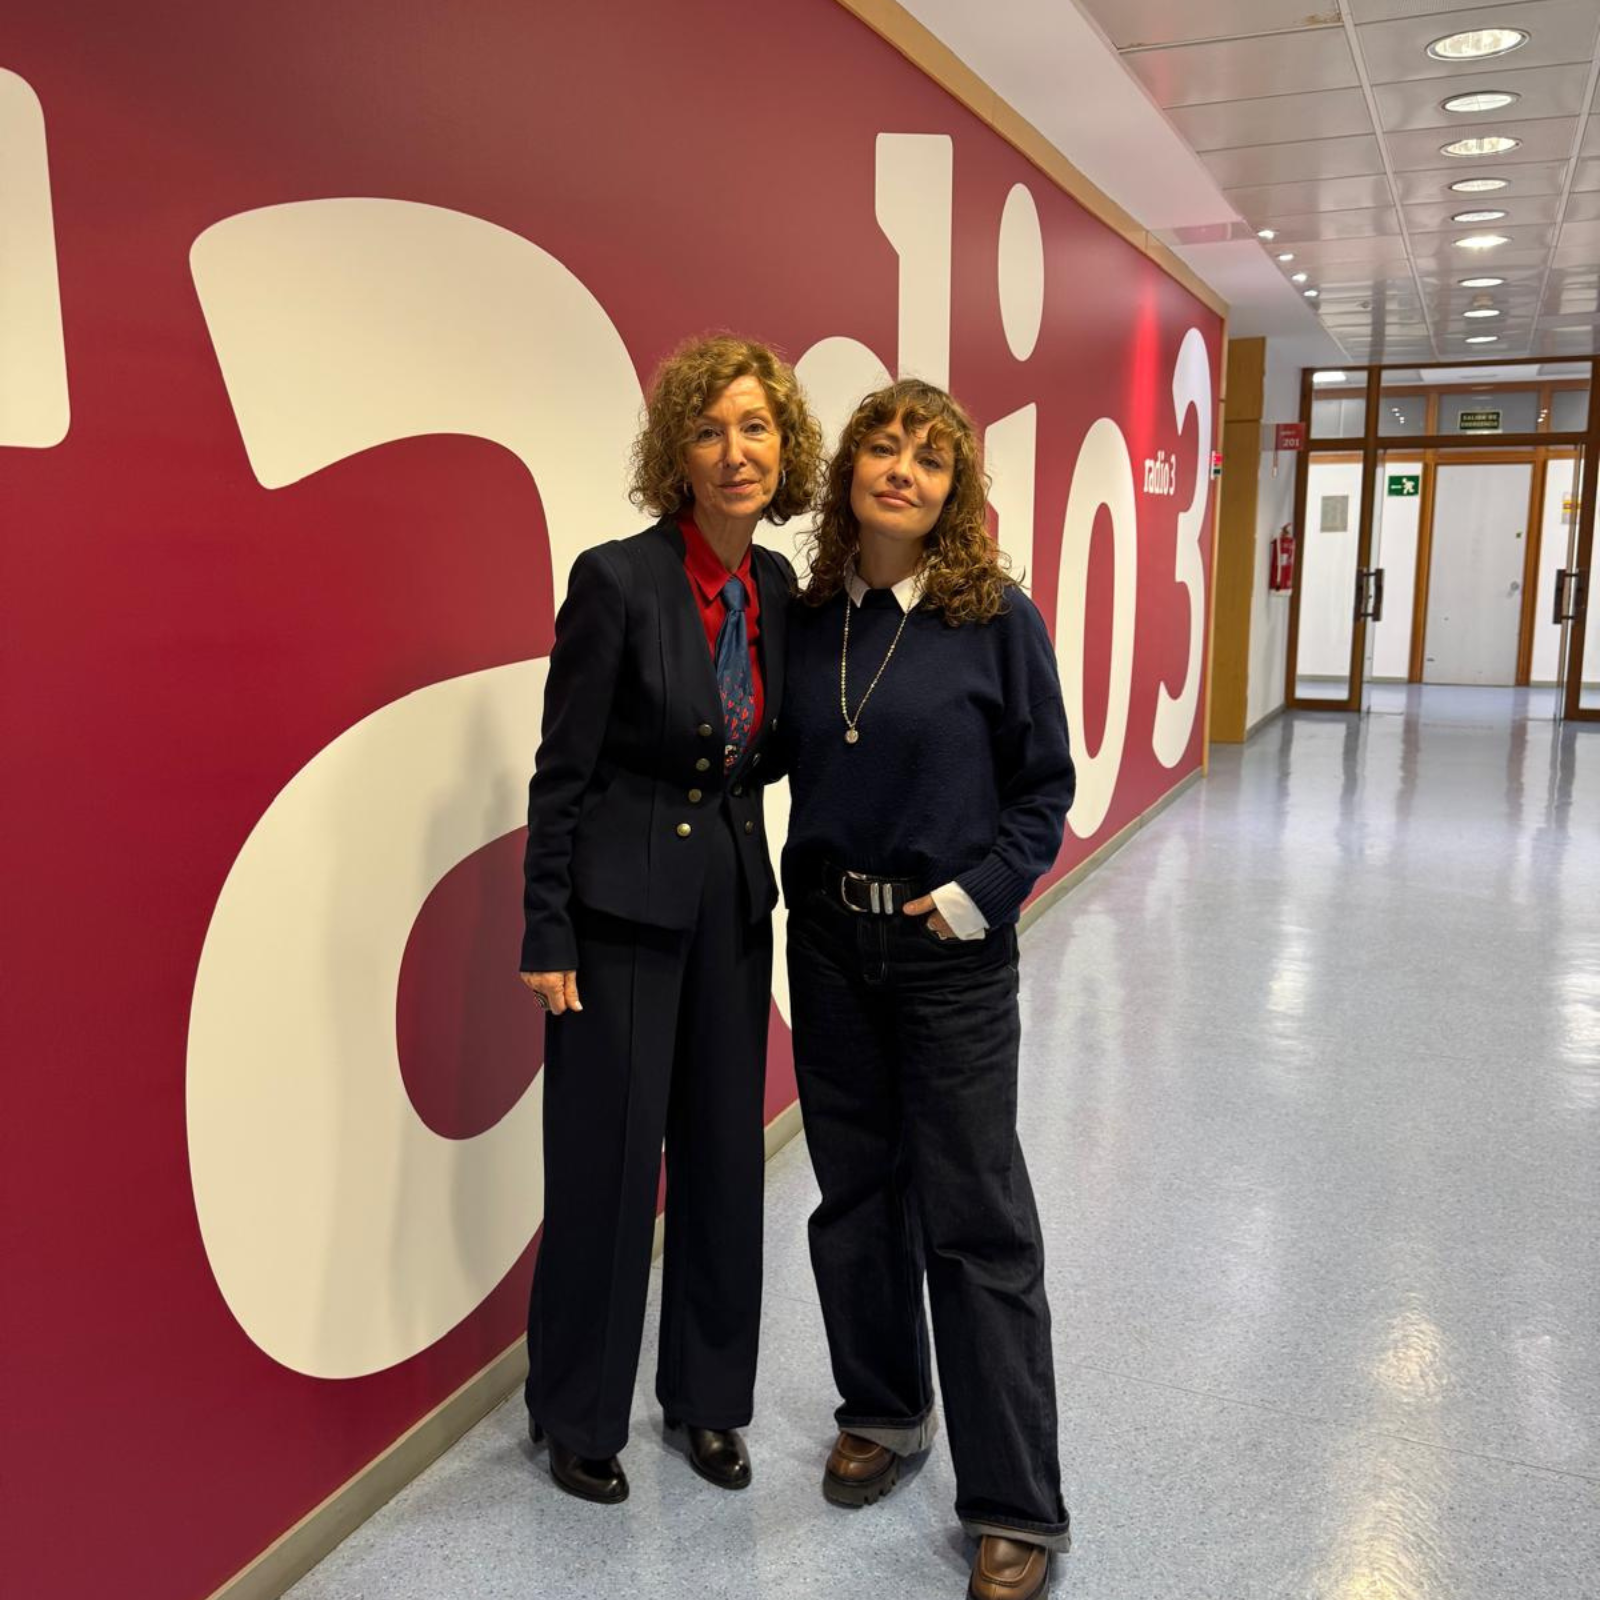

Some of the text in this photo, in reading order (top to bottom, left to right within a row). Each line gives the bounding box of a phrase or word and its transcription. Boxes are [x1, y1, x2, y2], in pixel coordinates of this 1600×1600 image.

[1282, 438, 1300, 447] 201
[1143, 450, 1176, 496] radio 3
[1151, 327, 1212, 769] 3
